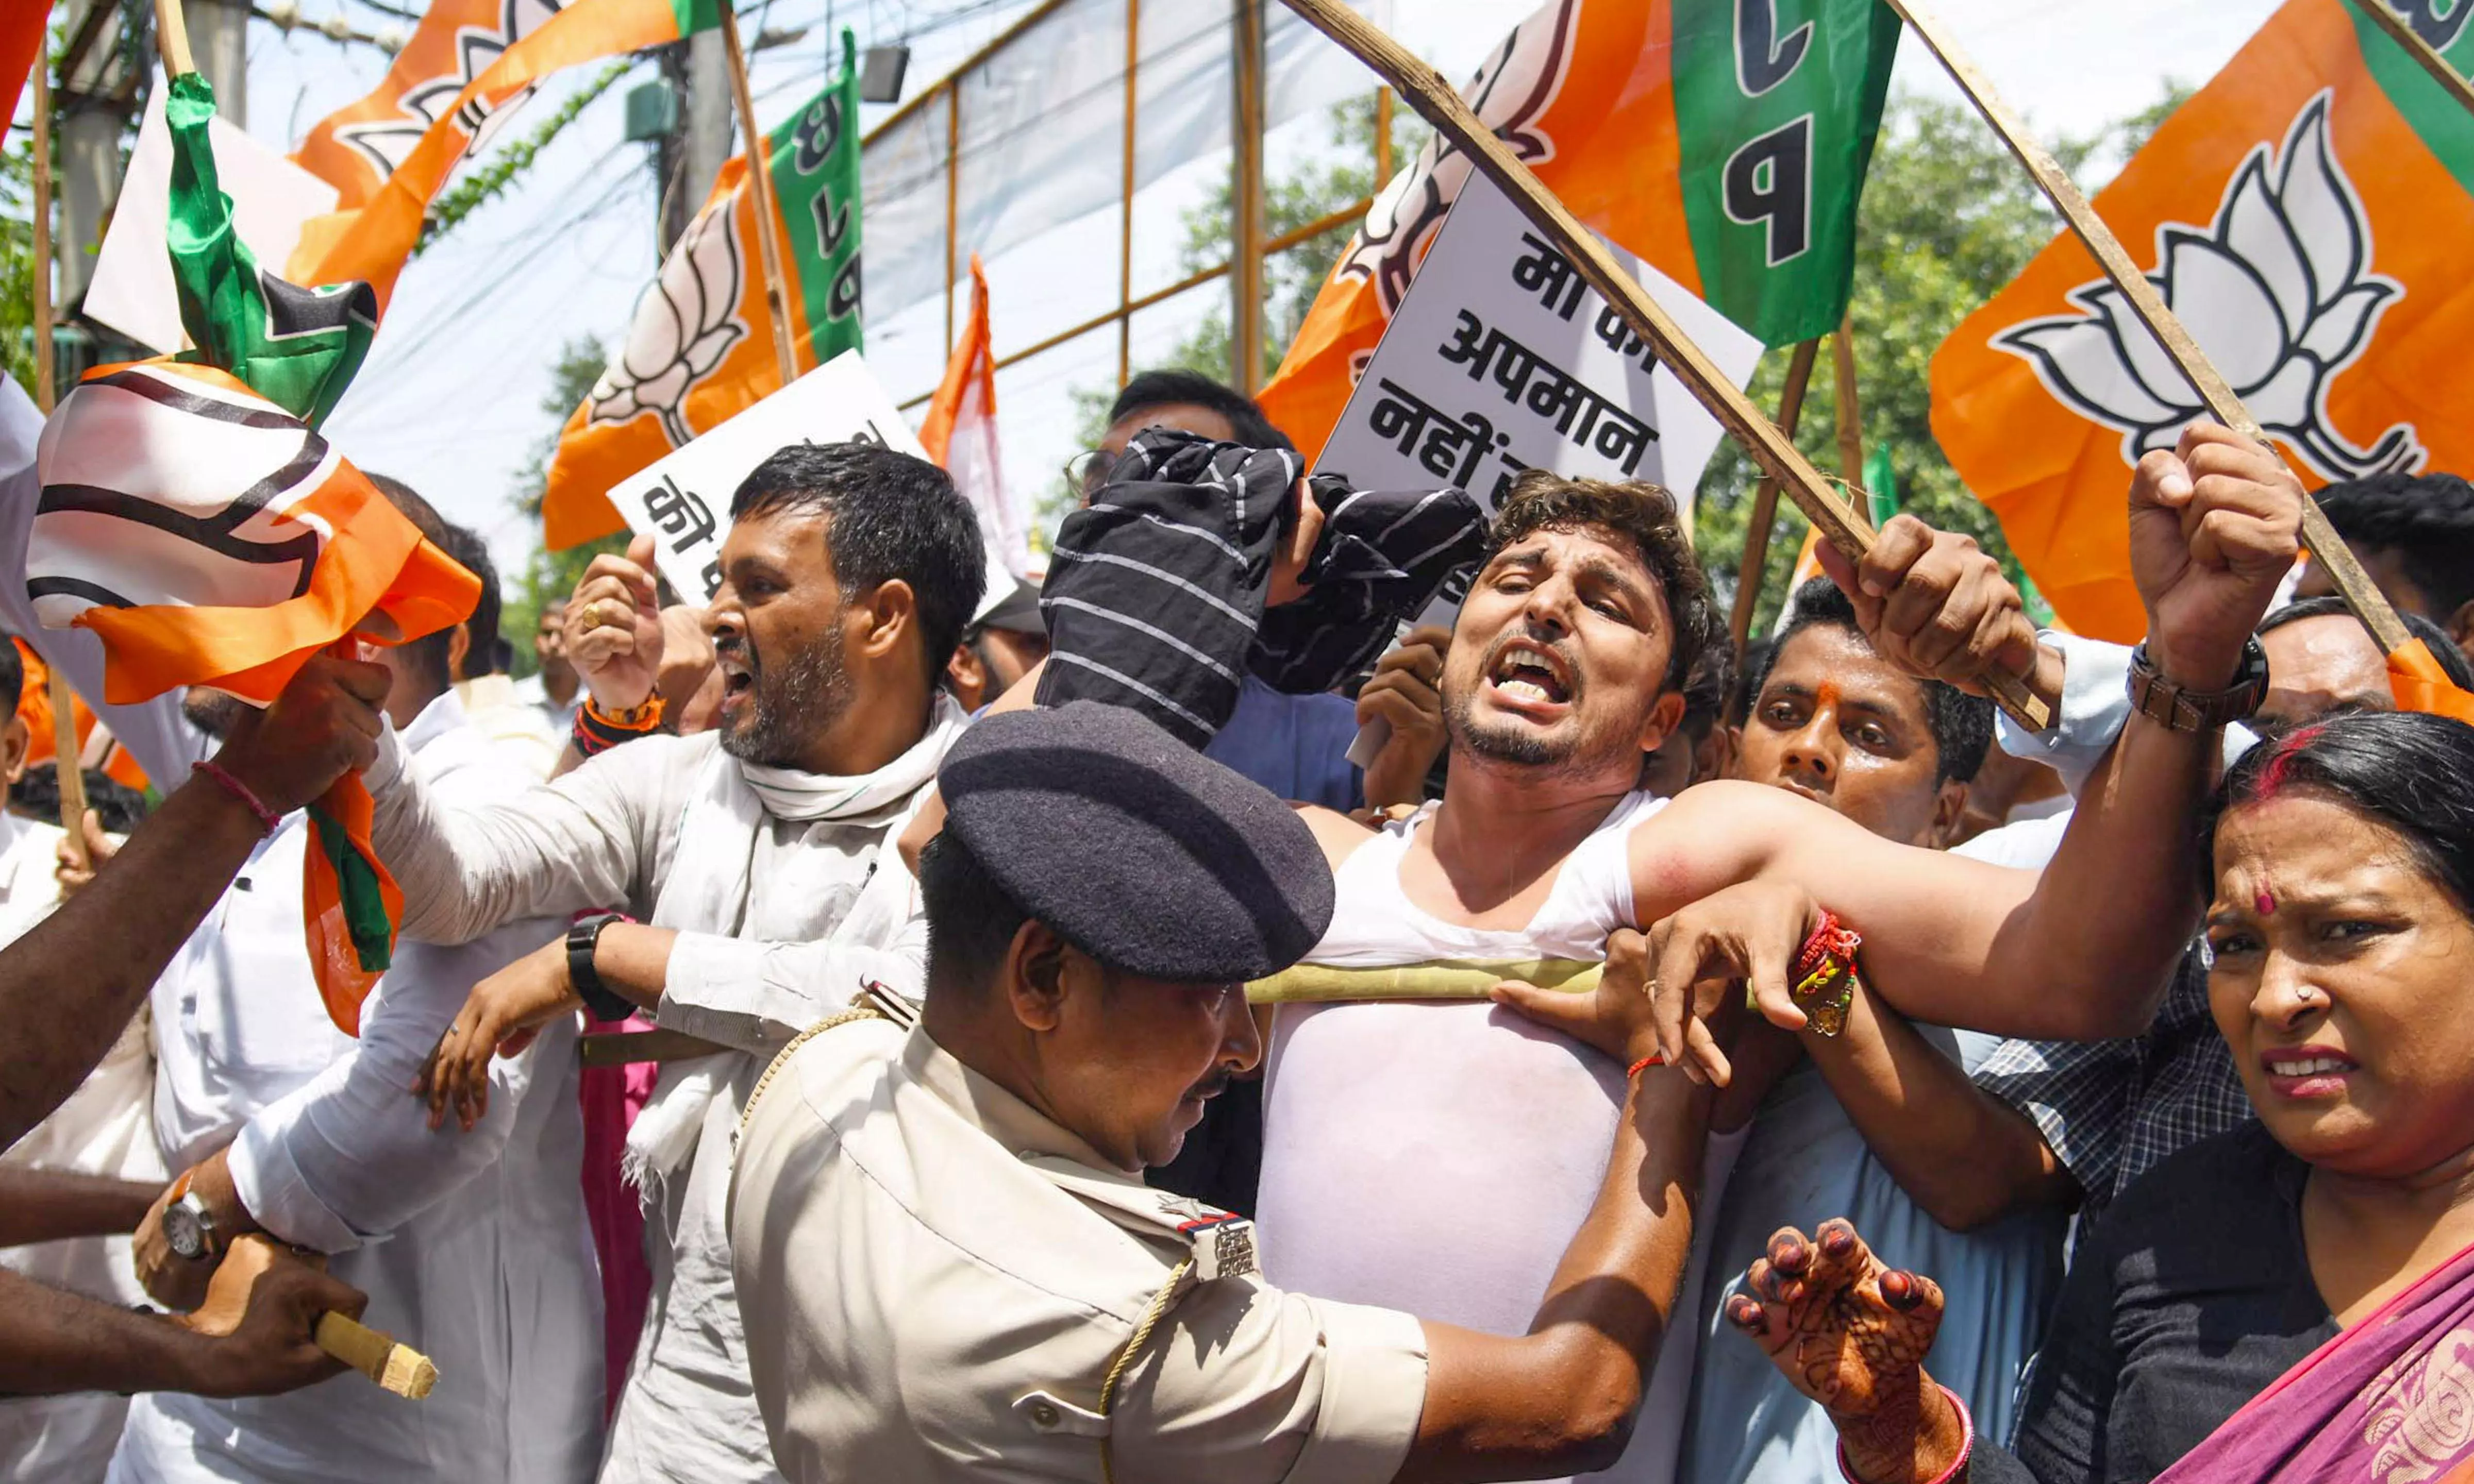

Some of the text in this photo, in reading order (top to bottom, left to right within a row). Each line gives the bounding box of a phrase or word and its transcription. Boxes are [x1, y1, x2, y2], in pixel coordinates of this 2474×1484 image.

[1369, 377, 1510, 491] नहीं
[1438, 308, 1660, 476] अपमान
[643, 474, 716, 554] की
